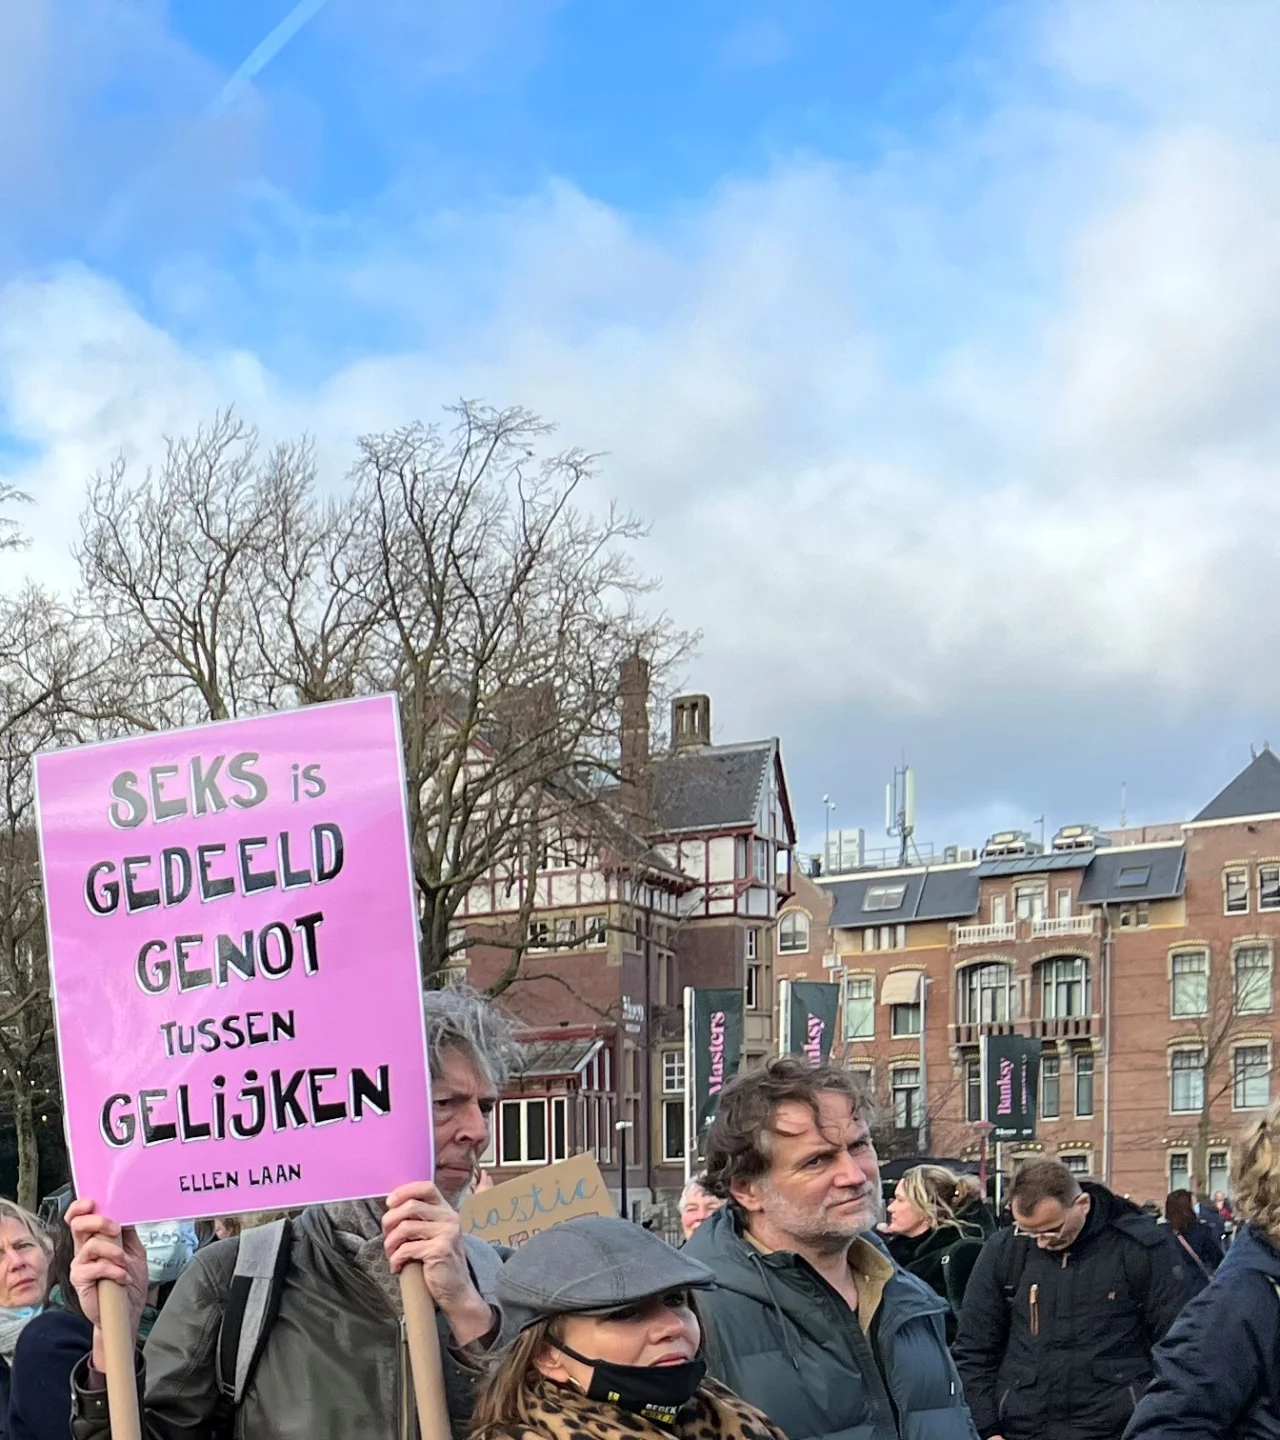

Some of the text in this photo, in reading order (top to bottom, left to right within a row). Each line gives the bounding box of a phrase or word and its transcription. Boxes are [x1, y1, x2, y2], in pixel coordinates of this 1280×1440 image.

[108, 753, 268, 830] SEKS
[84, 822, 345, 917] GEDEELD
[135, 912, 324, 995] GENOT
[179, 1163, 301, 1193] ELLEN LAAN
